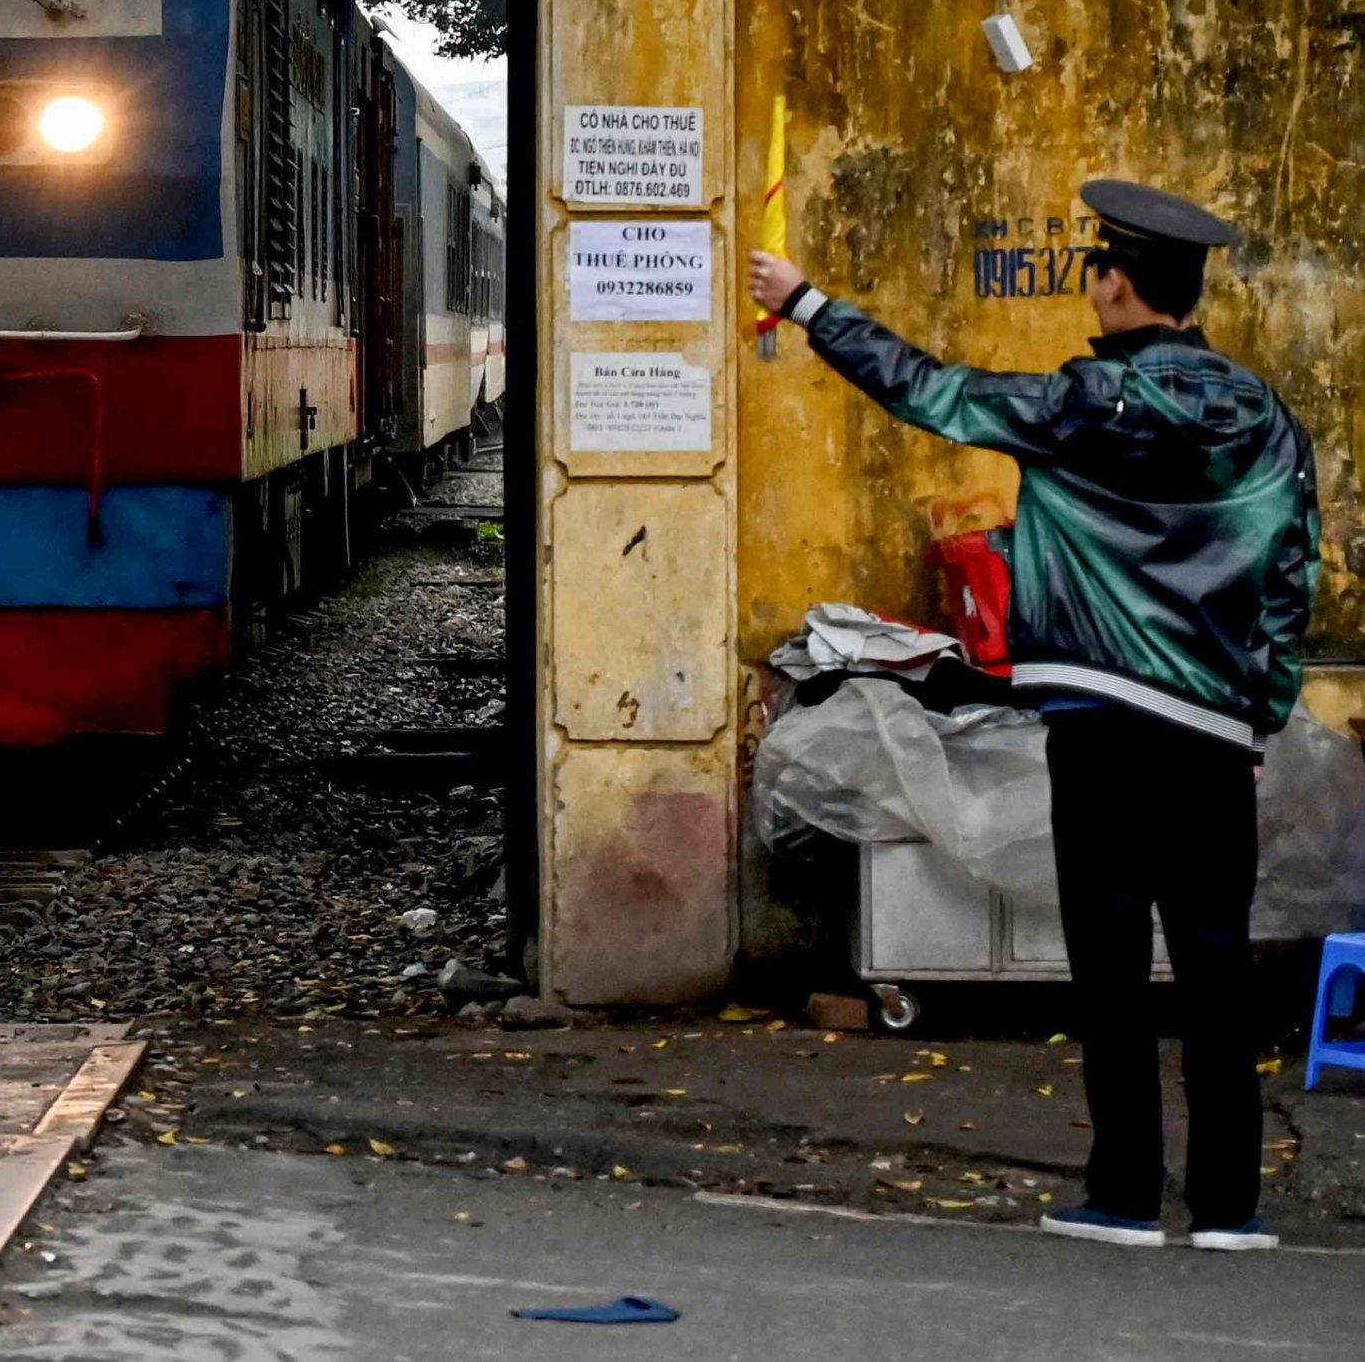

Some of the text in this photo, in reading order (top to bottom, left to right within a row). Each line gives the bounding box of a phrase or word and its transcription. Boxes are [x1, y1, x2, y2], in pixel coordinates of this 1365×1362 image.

[580, 109, 696, 131] CÓ NHÀ CHO THUÊ
[615, 181, 691, 198] 0876.602.469
[622, 226, 666, 241] CHO
[573, 249, 703, 270] THUÊ PHÒNG
[596, 280, 694, 297] 0932286859
